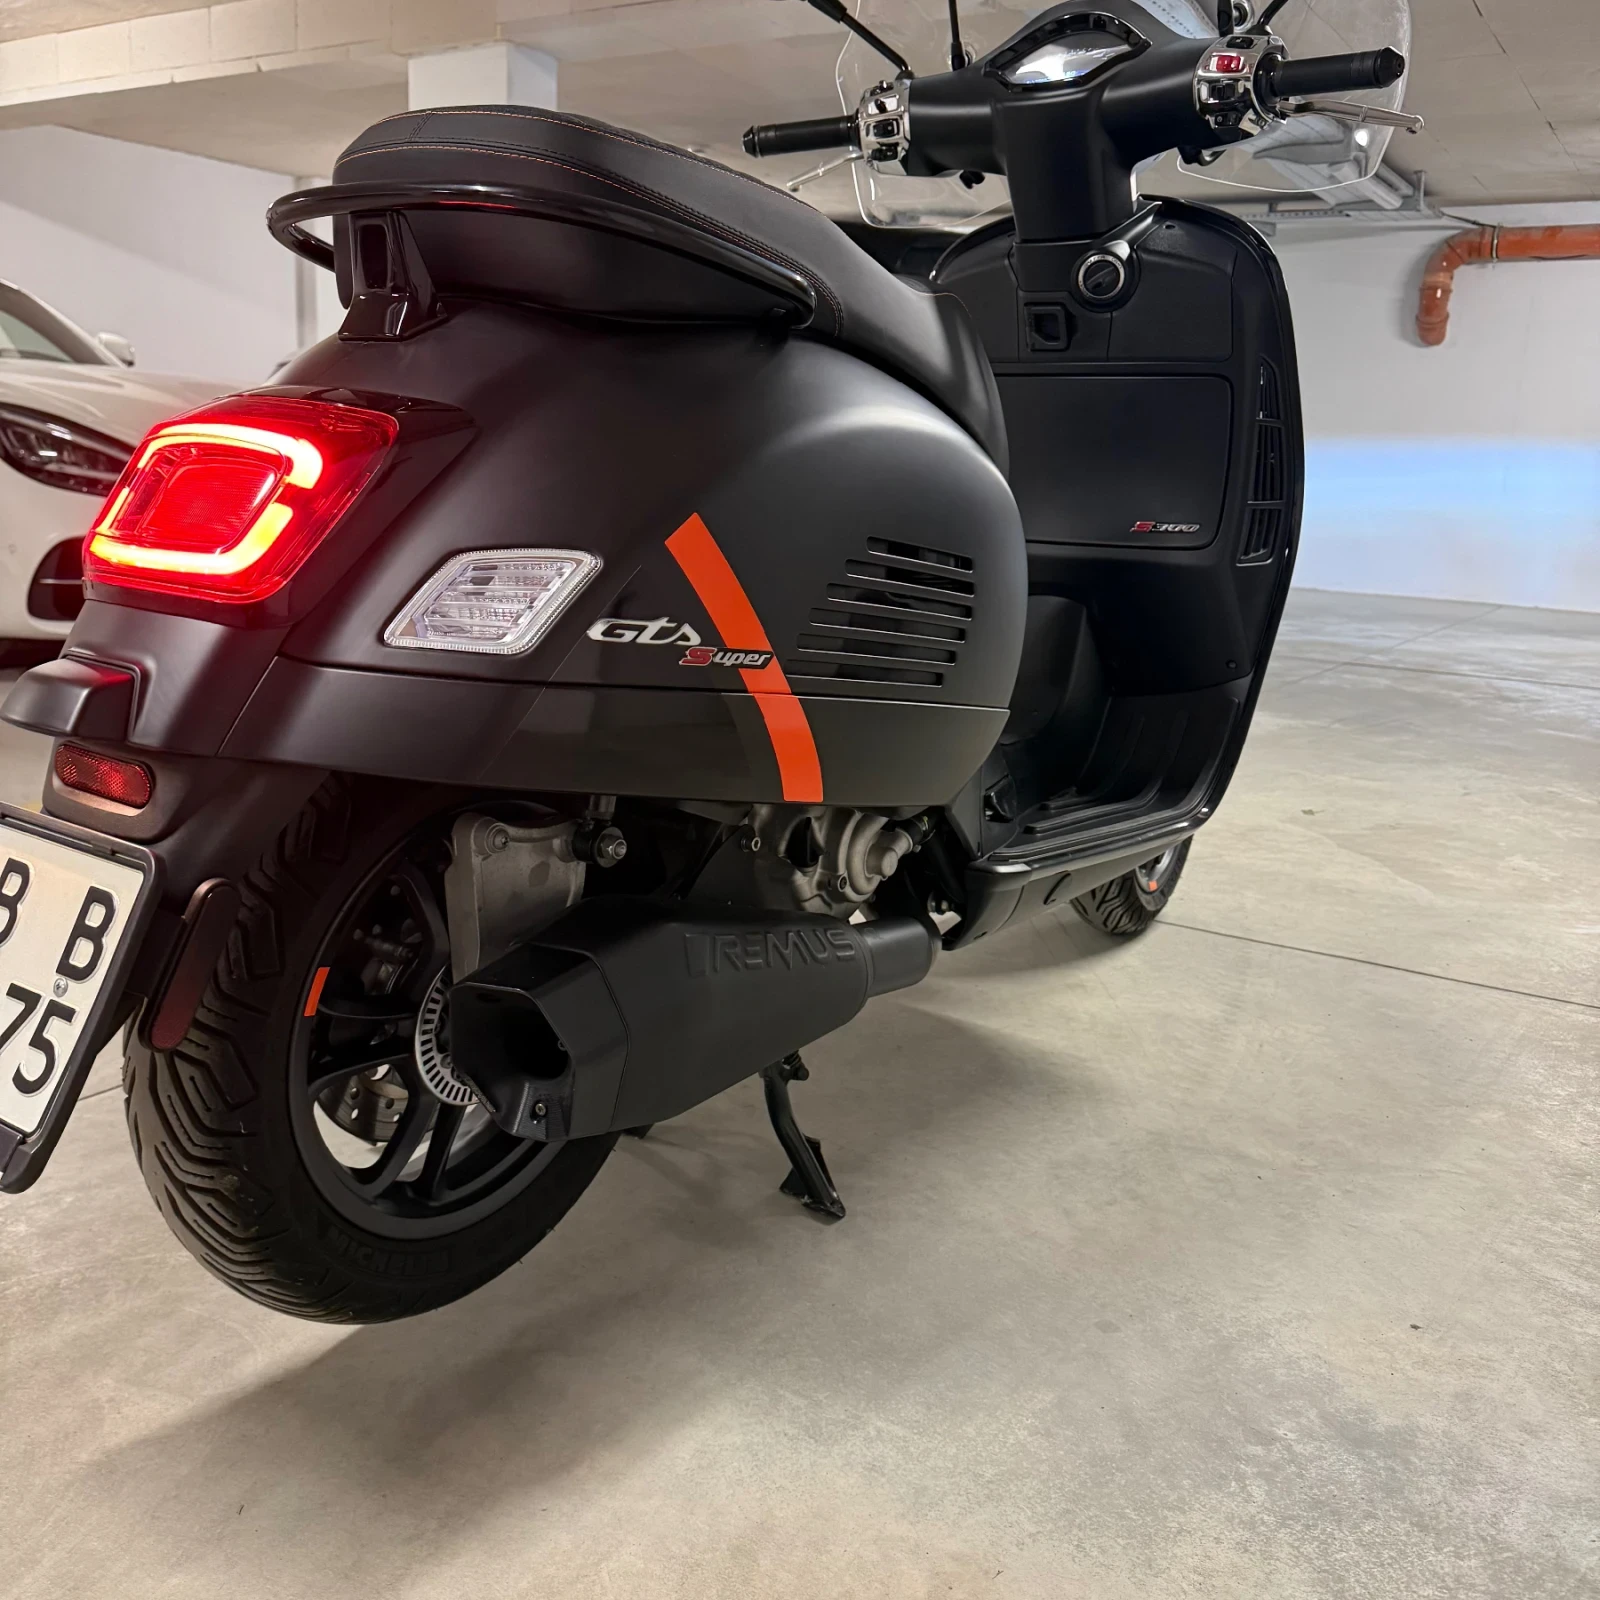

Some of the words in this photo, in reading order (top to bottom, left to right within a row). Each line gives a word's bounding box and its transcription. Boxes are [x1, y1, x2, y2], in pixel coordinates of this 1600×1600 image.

[679, 646, 771, 667] Super
[56, 885, 117, 982] B
[714, 928, 855, 972] REMUS
